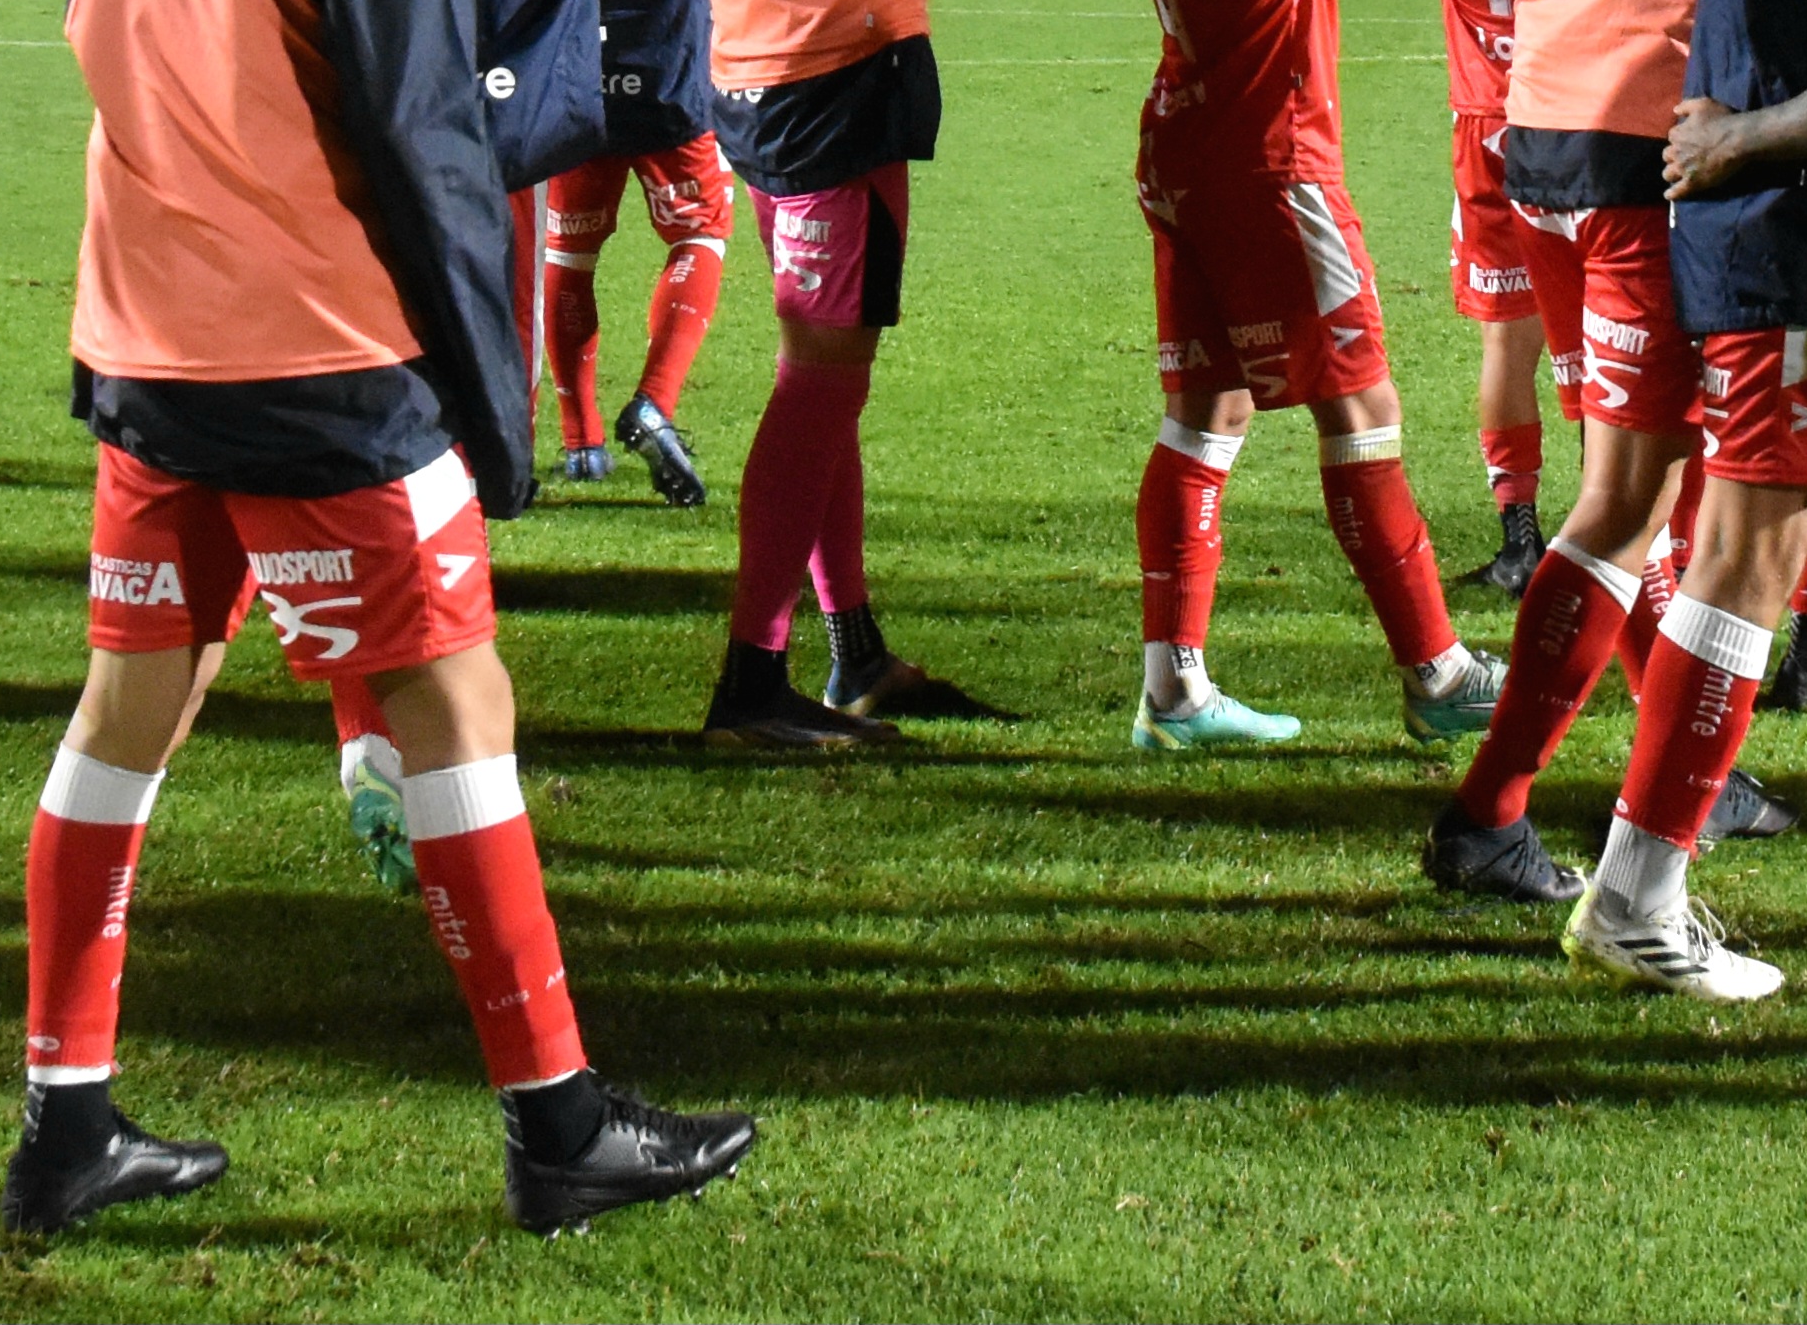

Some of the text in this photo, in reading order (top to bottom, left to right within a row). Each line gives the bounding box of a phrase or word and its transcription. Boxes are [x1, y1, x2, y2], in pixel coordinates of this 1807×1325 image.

[1333, 494, 1364, 552] mitre
[1690, 664, 1737, 739] mitre
[102, 864, 133, 940] mitre
[424, 884, 473, 962] mitre
